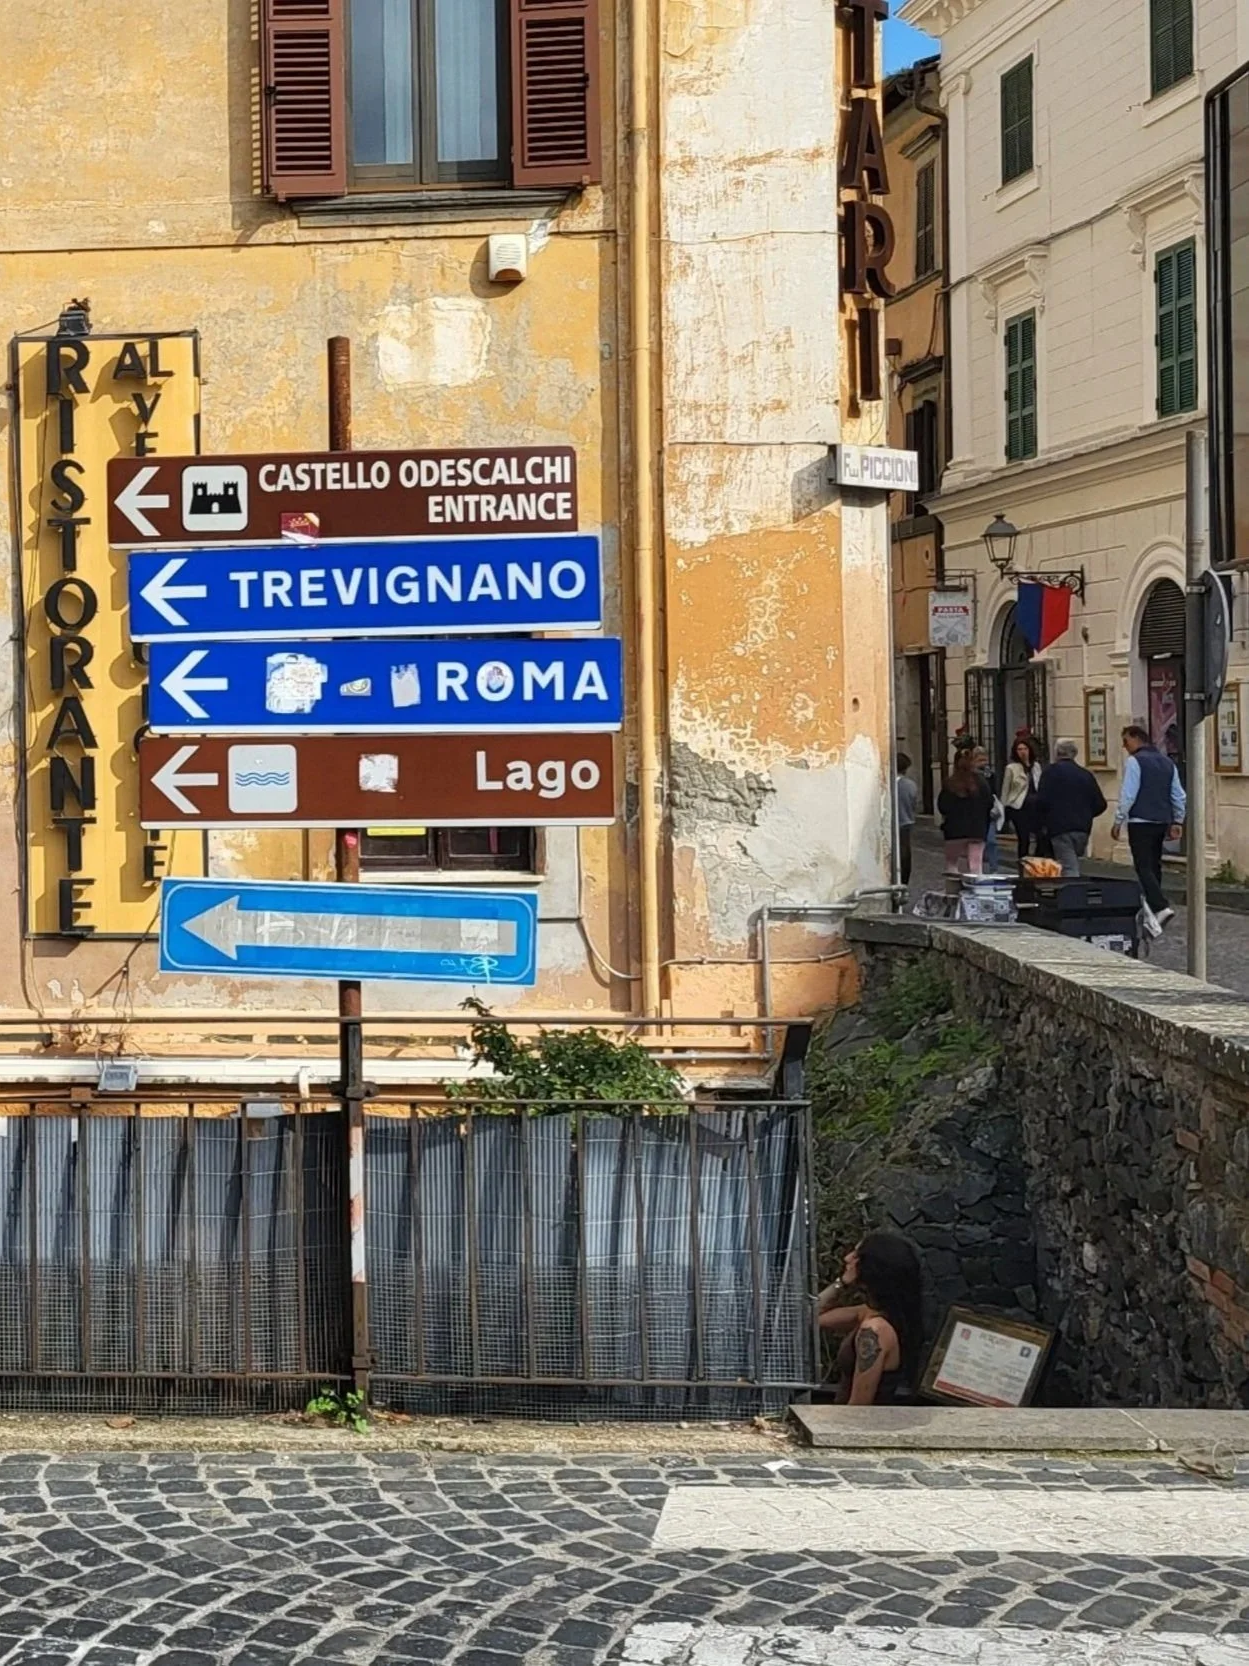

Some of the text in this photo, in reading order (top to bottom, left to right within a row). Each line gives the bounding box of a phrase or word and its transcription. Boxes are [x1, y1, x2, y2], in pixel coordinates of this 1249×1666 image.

[113, 340, 175, 380] AL
[259, 455, 571, 492] CASTELLO ODESCALCHI
[861, 455, 918, 483] PICCIONI
[428, 492, 572, 523] ENTRANCE
[228, 560, 586, 608] TREVIGNANO
[45, 340, 98, 932] RISTORANTE
[436, 660, 609, 702] ROMA
[475, 750, 601, 799] Lago
